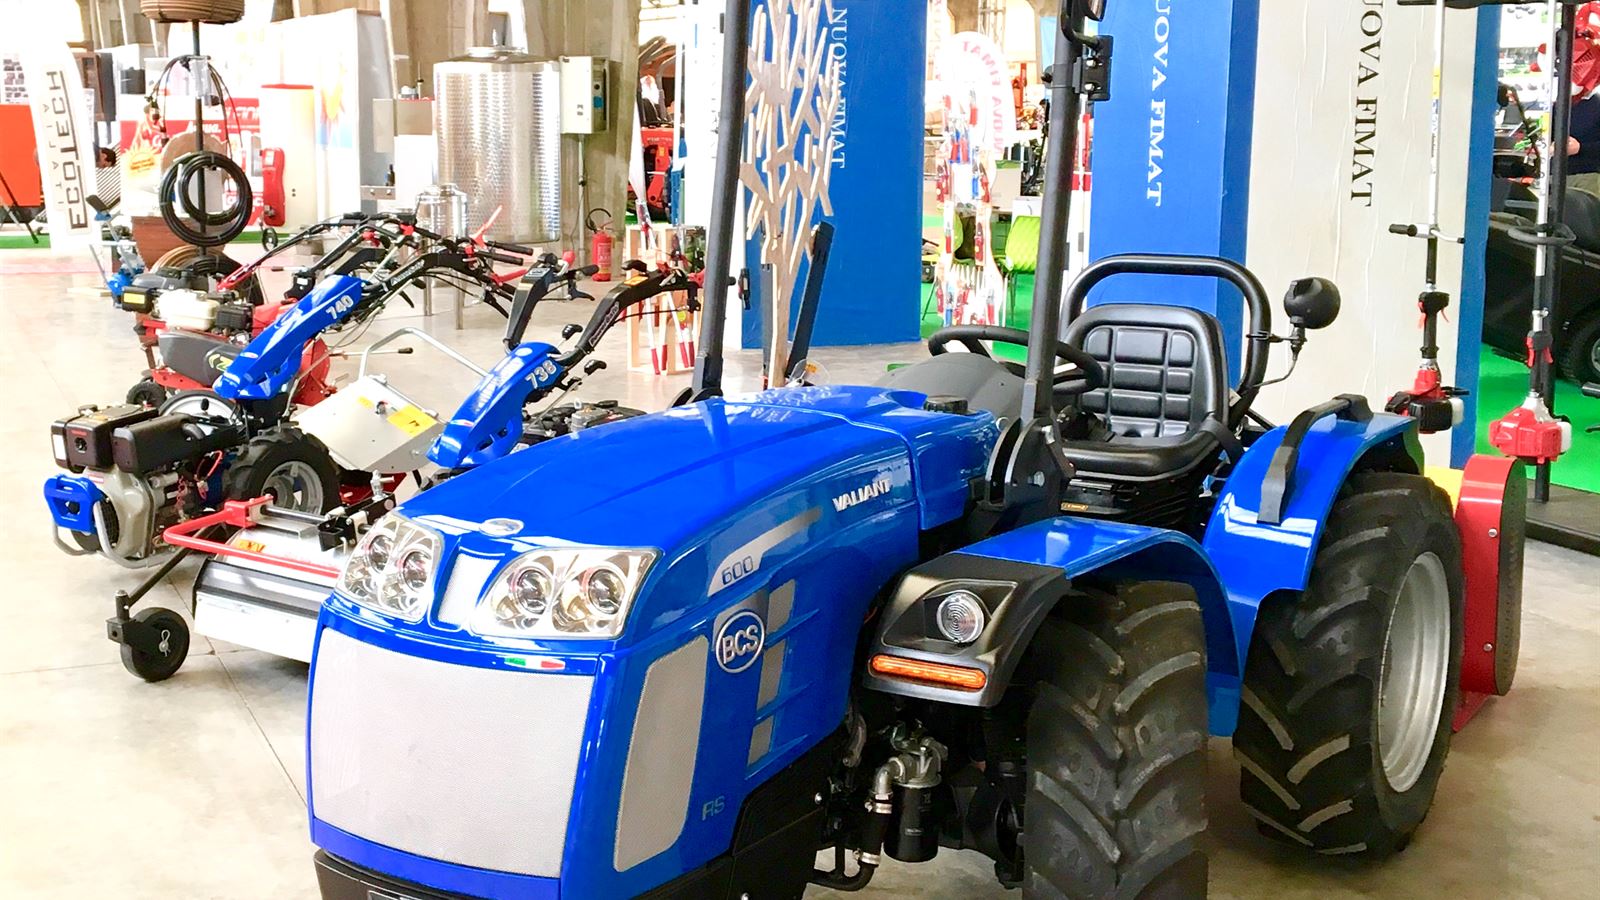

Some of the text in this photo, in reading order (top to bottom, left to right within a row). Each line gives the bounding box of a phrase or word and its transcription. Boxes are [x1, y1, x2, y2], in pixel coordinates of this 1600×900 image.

[46, 70, 89, 230] ECOTECH
[1147, 98, 1166, 207] FIMAT
[1350, 95, 1378, 208] FIMAT
[325, 294, 354, 320] 740
[524, 359, 557, 390] 738
[832, 478, 893, 513] VALIANT
[721, 555, 754, 586] 600
[722, 624, 759, 665] BCS
